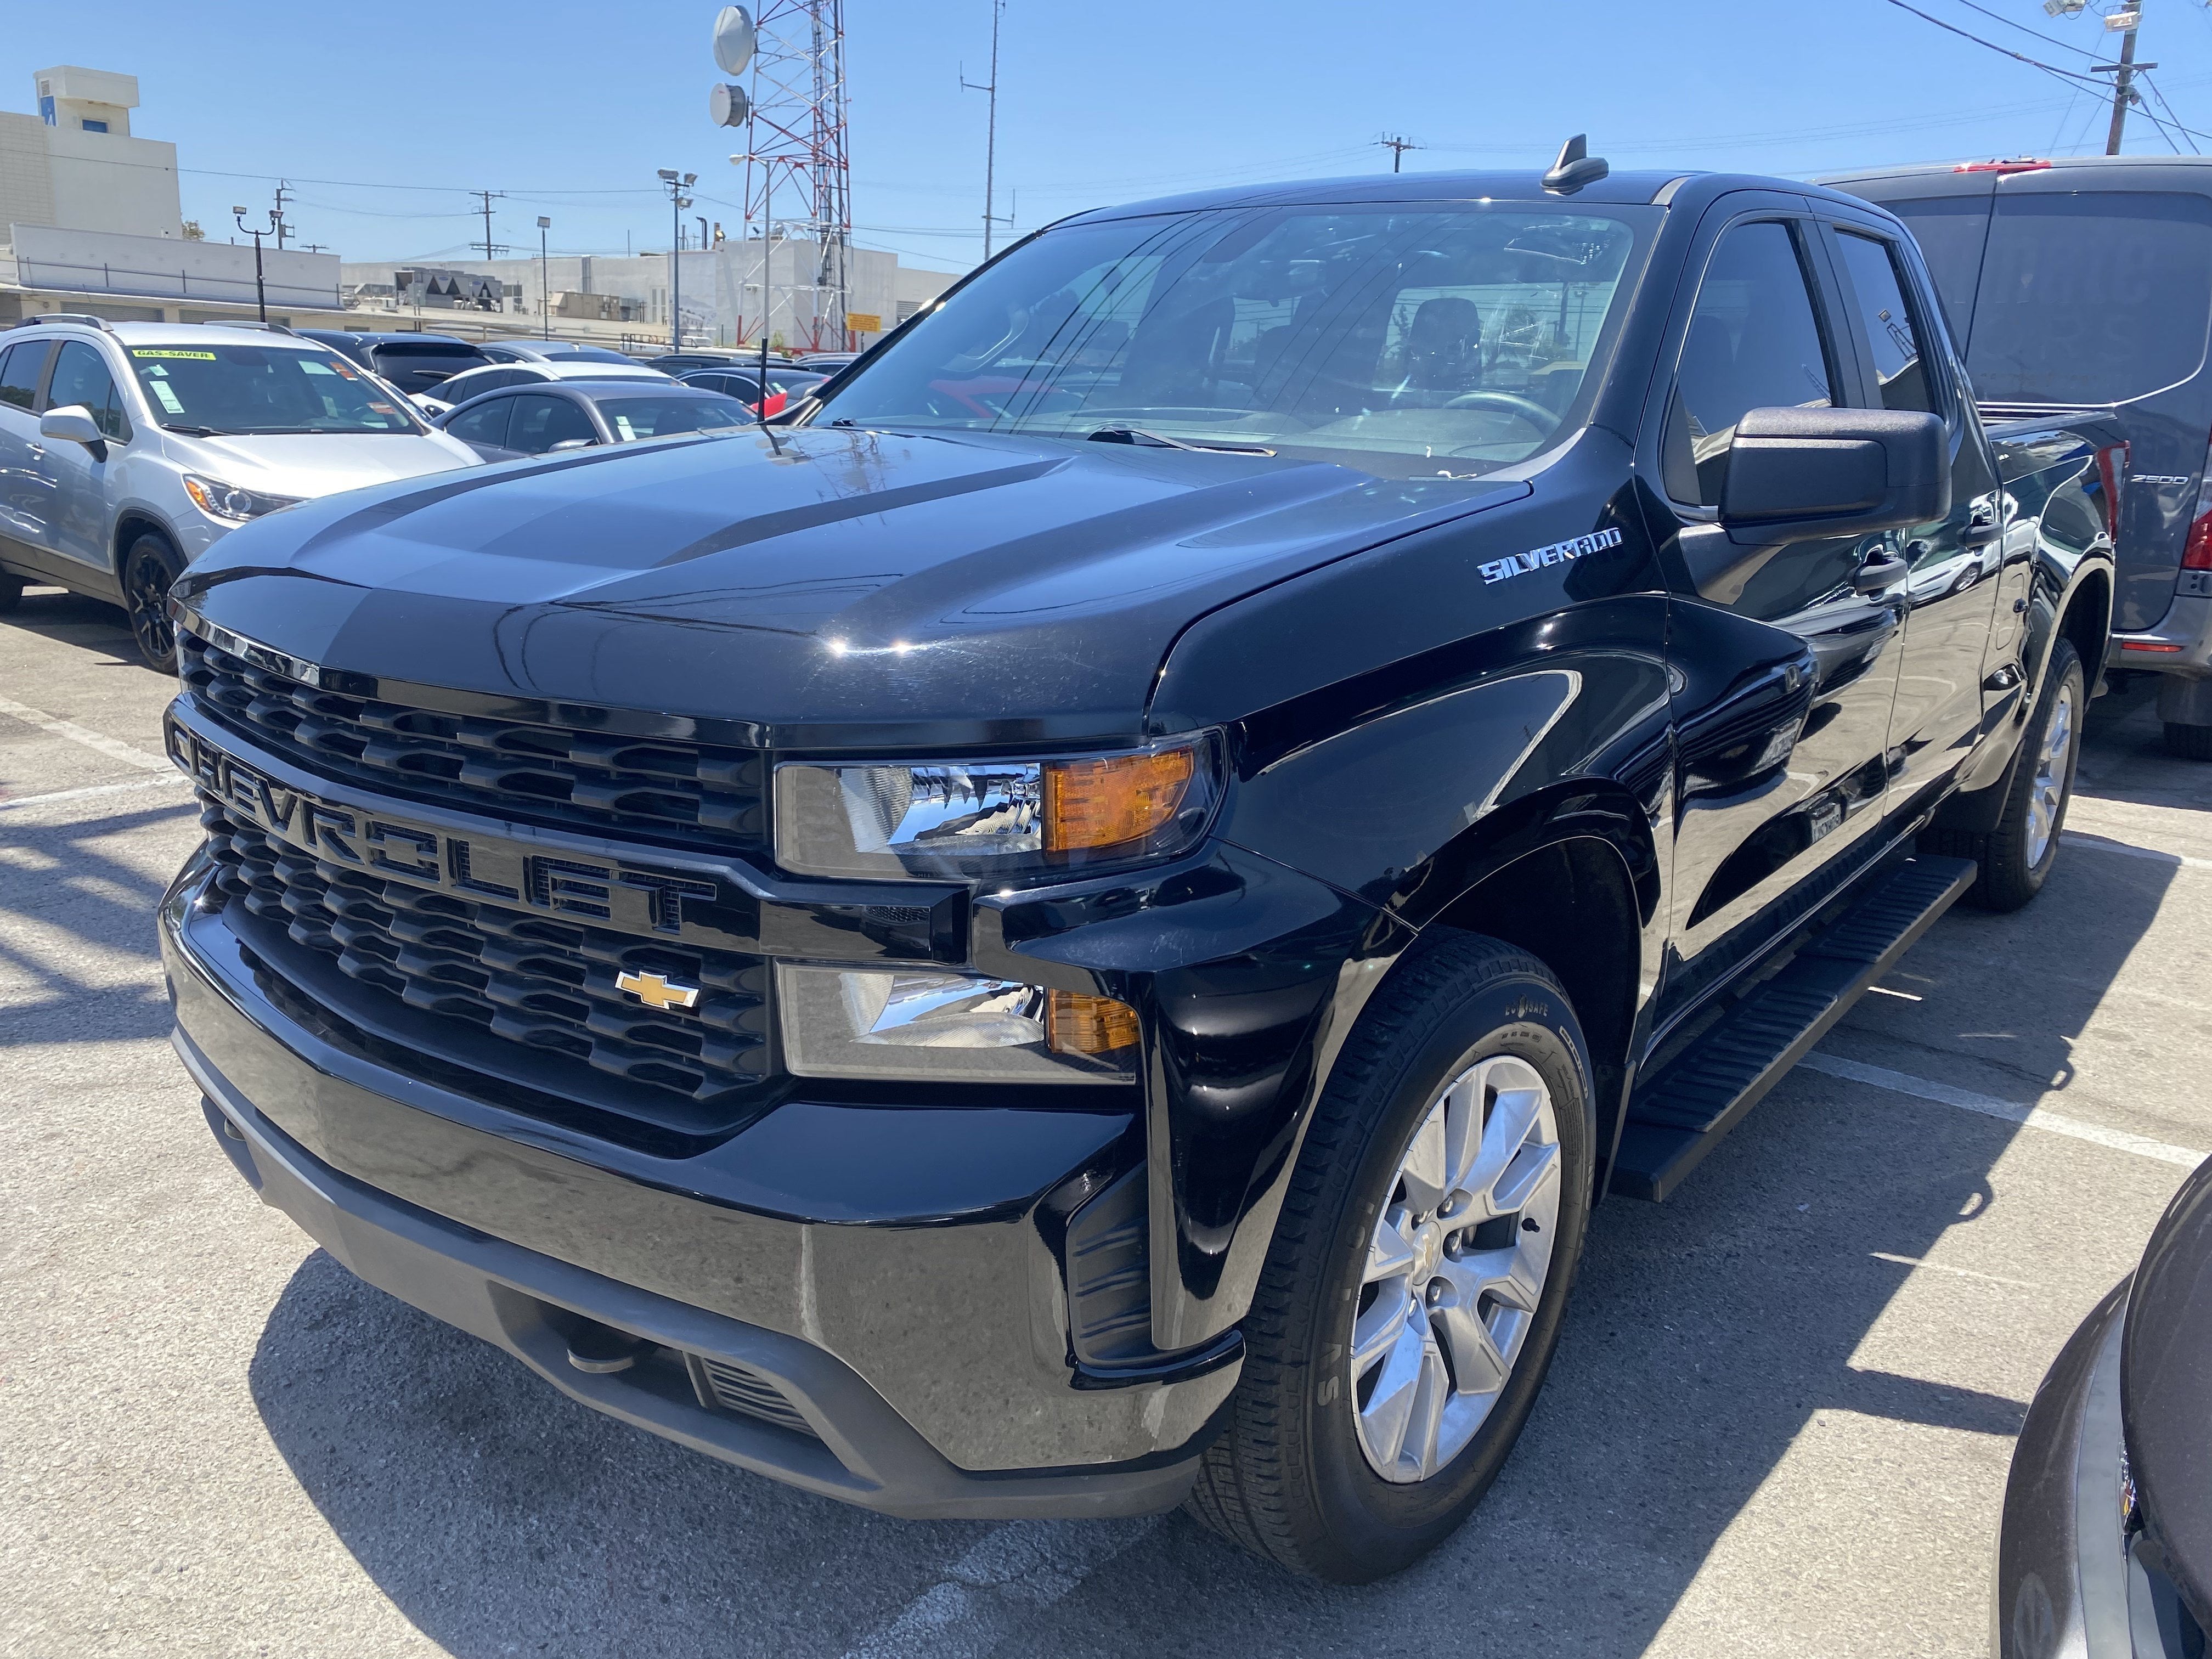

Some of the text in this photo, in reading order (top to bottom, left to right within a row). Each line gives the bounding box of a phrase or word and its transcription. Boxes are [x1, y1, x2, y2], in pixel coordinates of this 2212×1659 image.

[2131, 475, 2189, 485] 2500
[1476, 527, 1623, 585] SILVERADO
[171, 727, 718, 935] CHEVROLET
